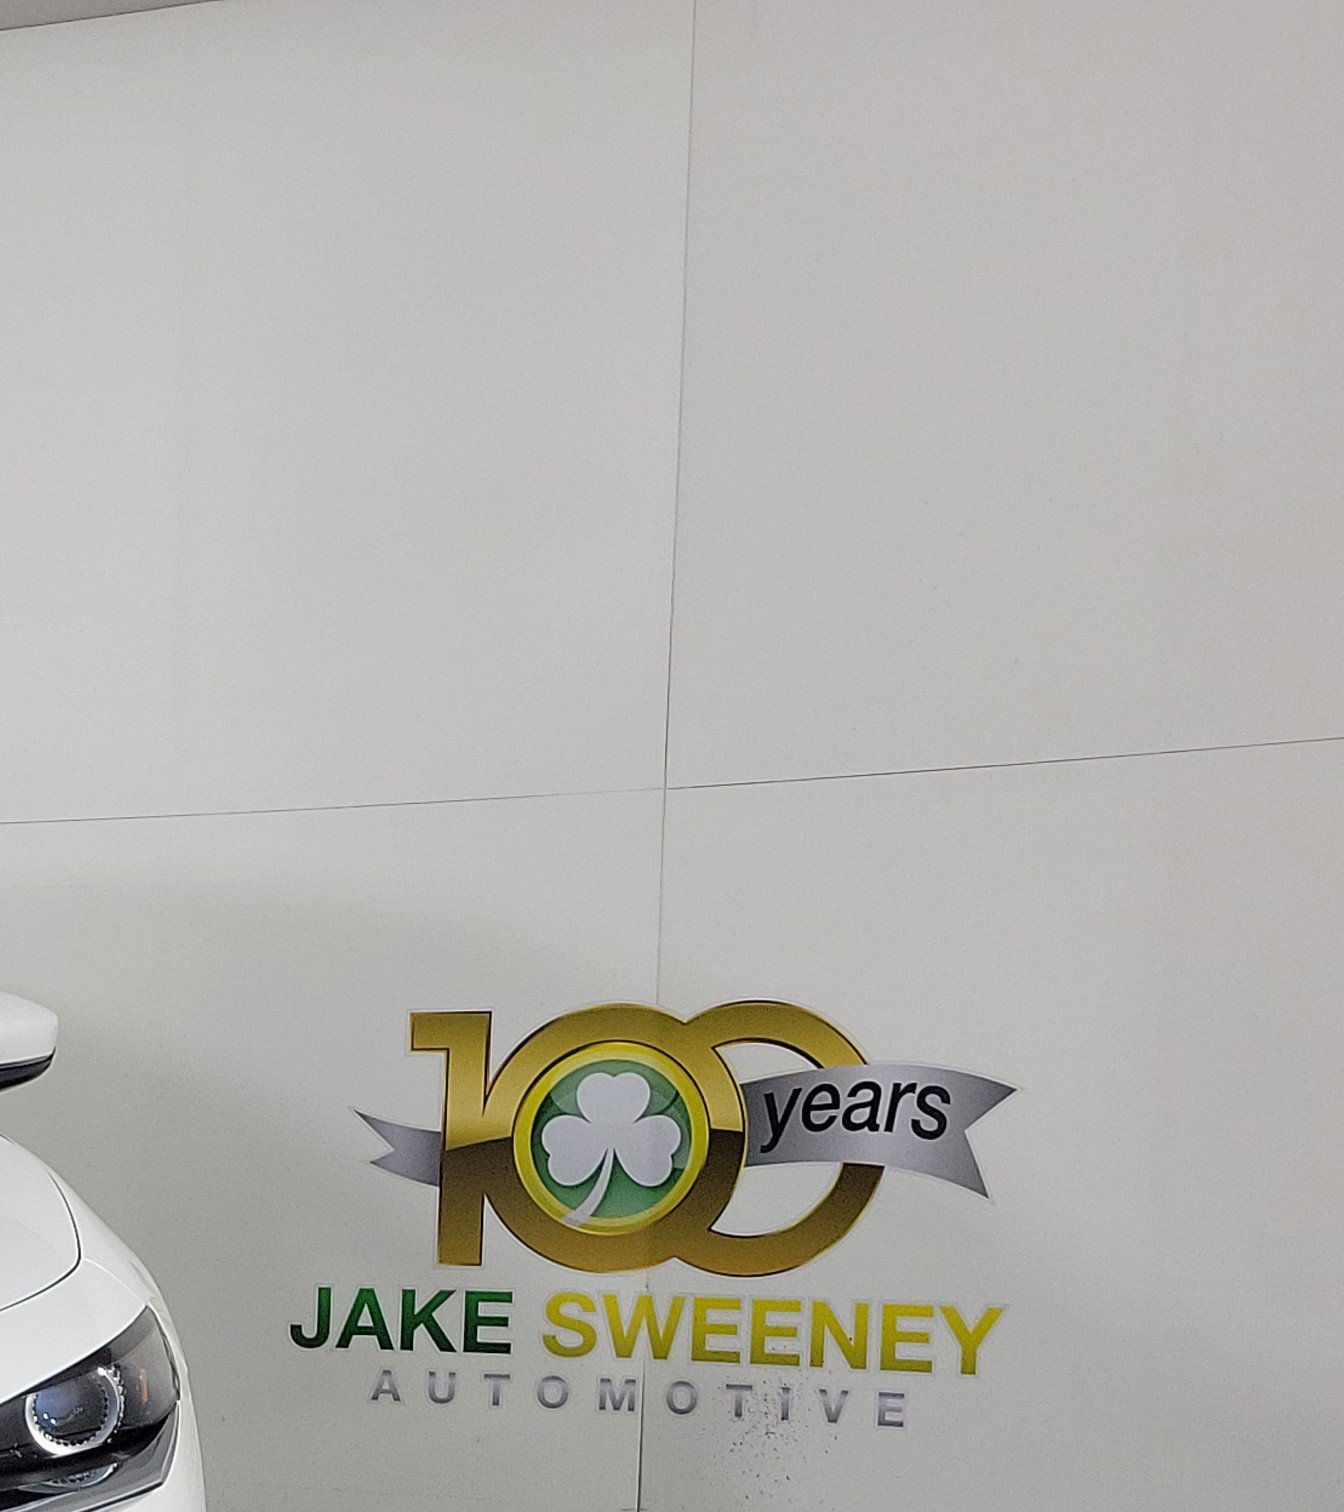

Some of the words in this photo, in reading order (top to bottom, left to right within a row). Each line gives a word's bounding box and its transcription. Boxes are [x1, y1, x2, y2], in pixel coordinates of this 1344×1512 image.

[410, 1000, 885, 1277] 100
[761, 1079, 952, 1155] years
[290, 1286, 513, 1354] JAKE
[542, 1293, 1003, 1376] SWEENEY
[370, 1369, 906, 1428] AUTOMOTIVE
